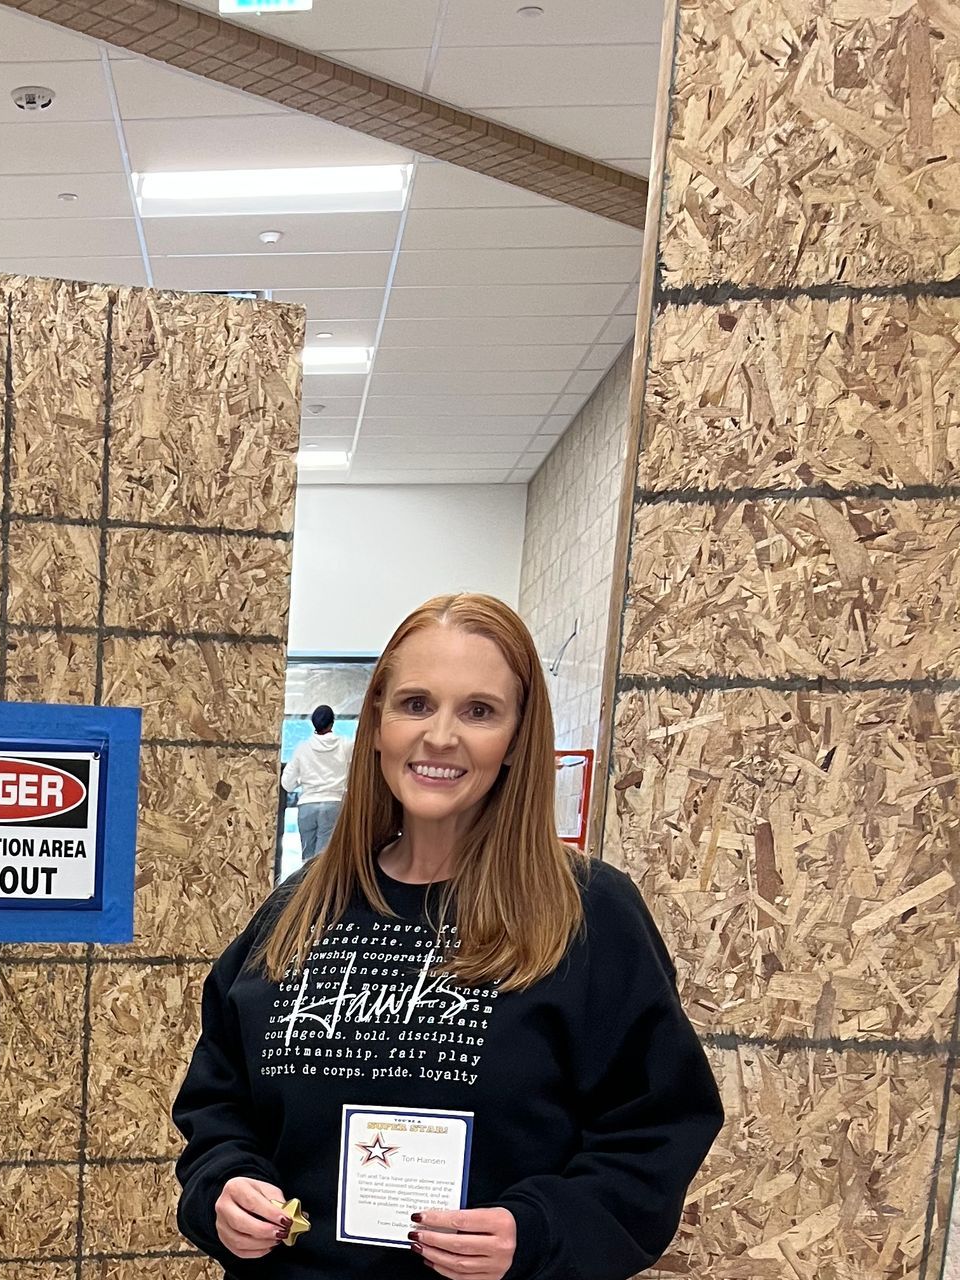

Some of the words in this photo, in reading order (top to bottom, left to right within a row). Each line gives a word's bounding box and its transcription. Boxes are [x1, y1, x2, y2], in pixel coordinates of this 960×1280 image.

[38, 839, 86, 858] AREA
[0, 866, 57, 894] OUT
[372, 922, 428, 934] brave.
[415, 939, 461, 949] solid
[362, 951, 448, 964] cooperation.
[316, 981, 353, 990] wor.
[355, 1030, 390, 1041] bold.
[398, 1030, 485, 1046] discipline
[261, 1045, 379, 1061] sportmanship.
[388, 1047, 427, 1059] fair
[437, 1050, 481, 1066] play
[260, 1063, 296, 1077] esprit
[302, 1063, 317, 1075] de
[323, 1066, 365, 1079] corps.
[372, 1066, 413, 1080] pride.
[419, 1066, 478, 1085] loyalty
